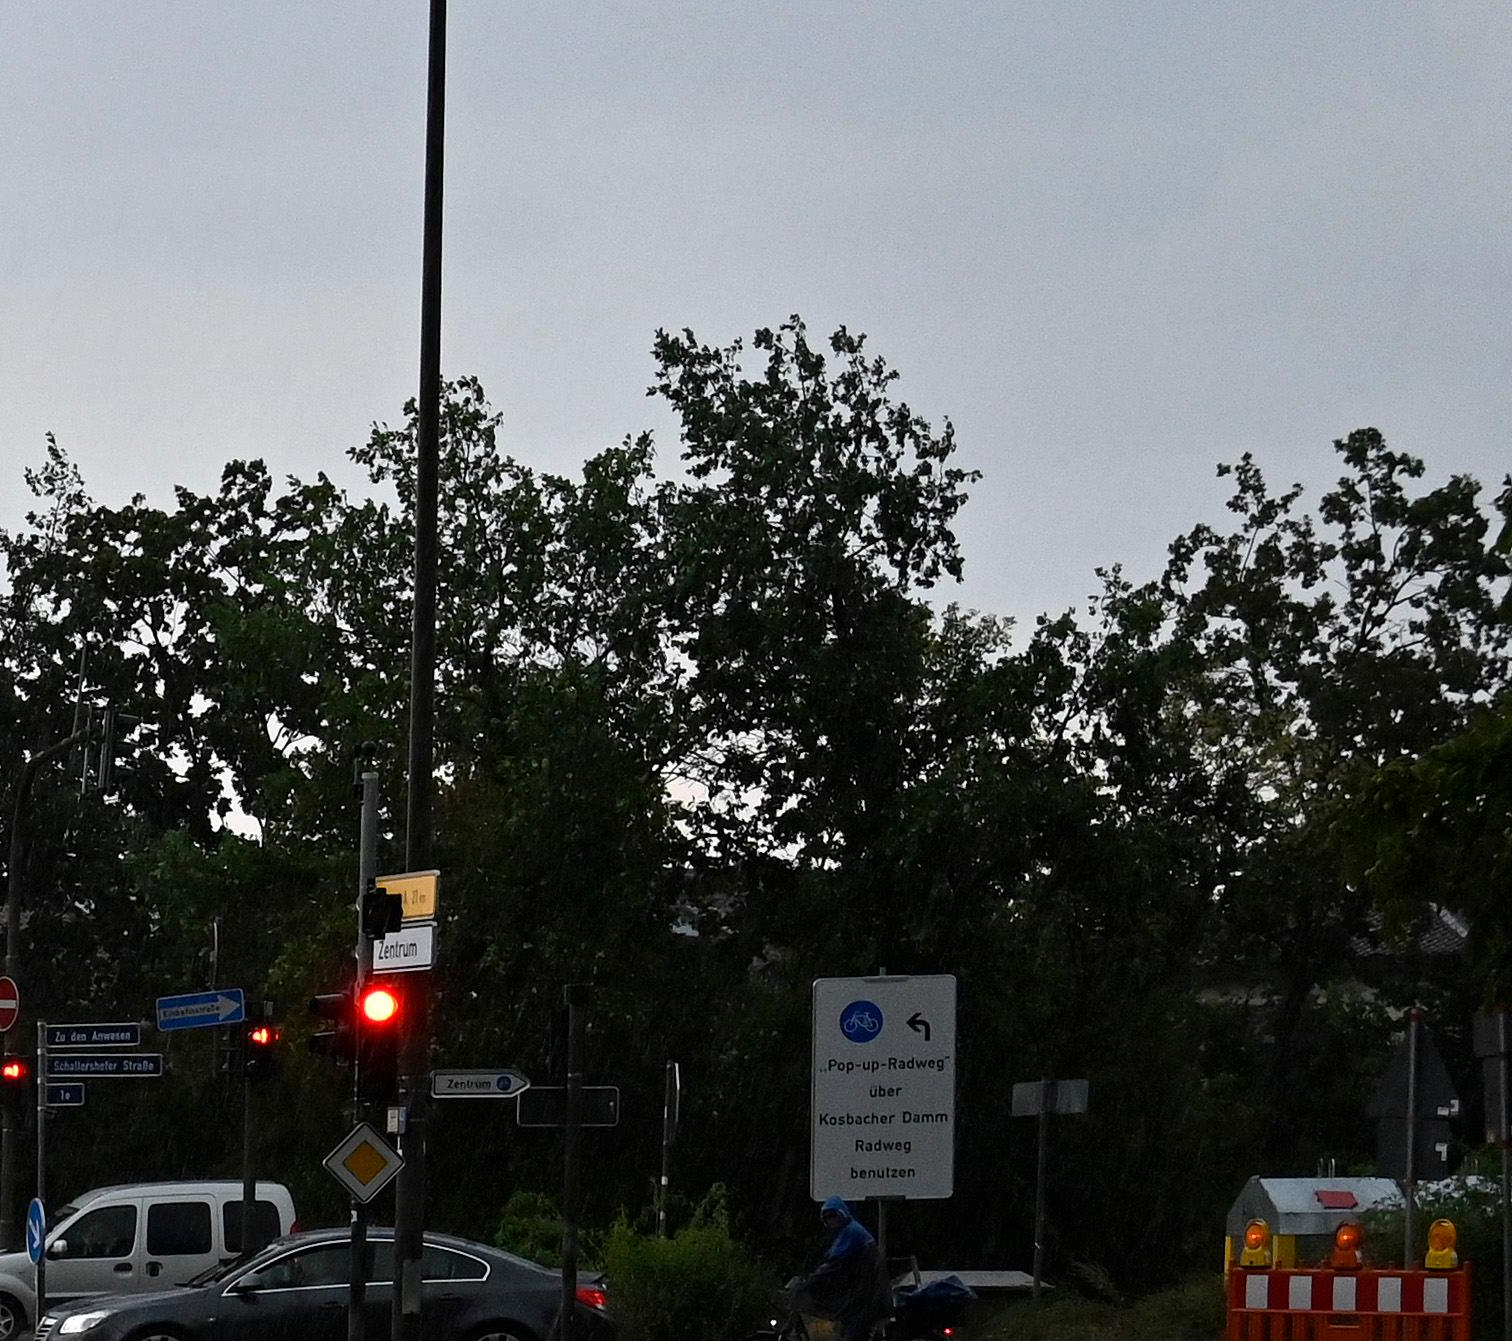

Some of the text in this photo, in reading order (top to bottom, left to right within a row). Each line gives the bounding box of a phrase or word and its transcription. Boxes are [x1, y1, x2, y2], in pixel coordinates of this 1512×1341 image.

[378, 940, 418, 960] Zentrum
[54, 1030, 131, 1043] Zu den Anwesen
[122, 1060, 154, 1072] Straße
[447, 1079, 492, 1090] Zentrum
[869, 1085, 902, 1098] über
[819, 1110, 948, 1126] Kosbacher Damm
[855, 1140, 912, 1155] Radweg
[850, 1168, 916, 1180] benutzen
